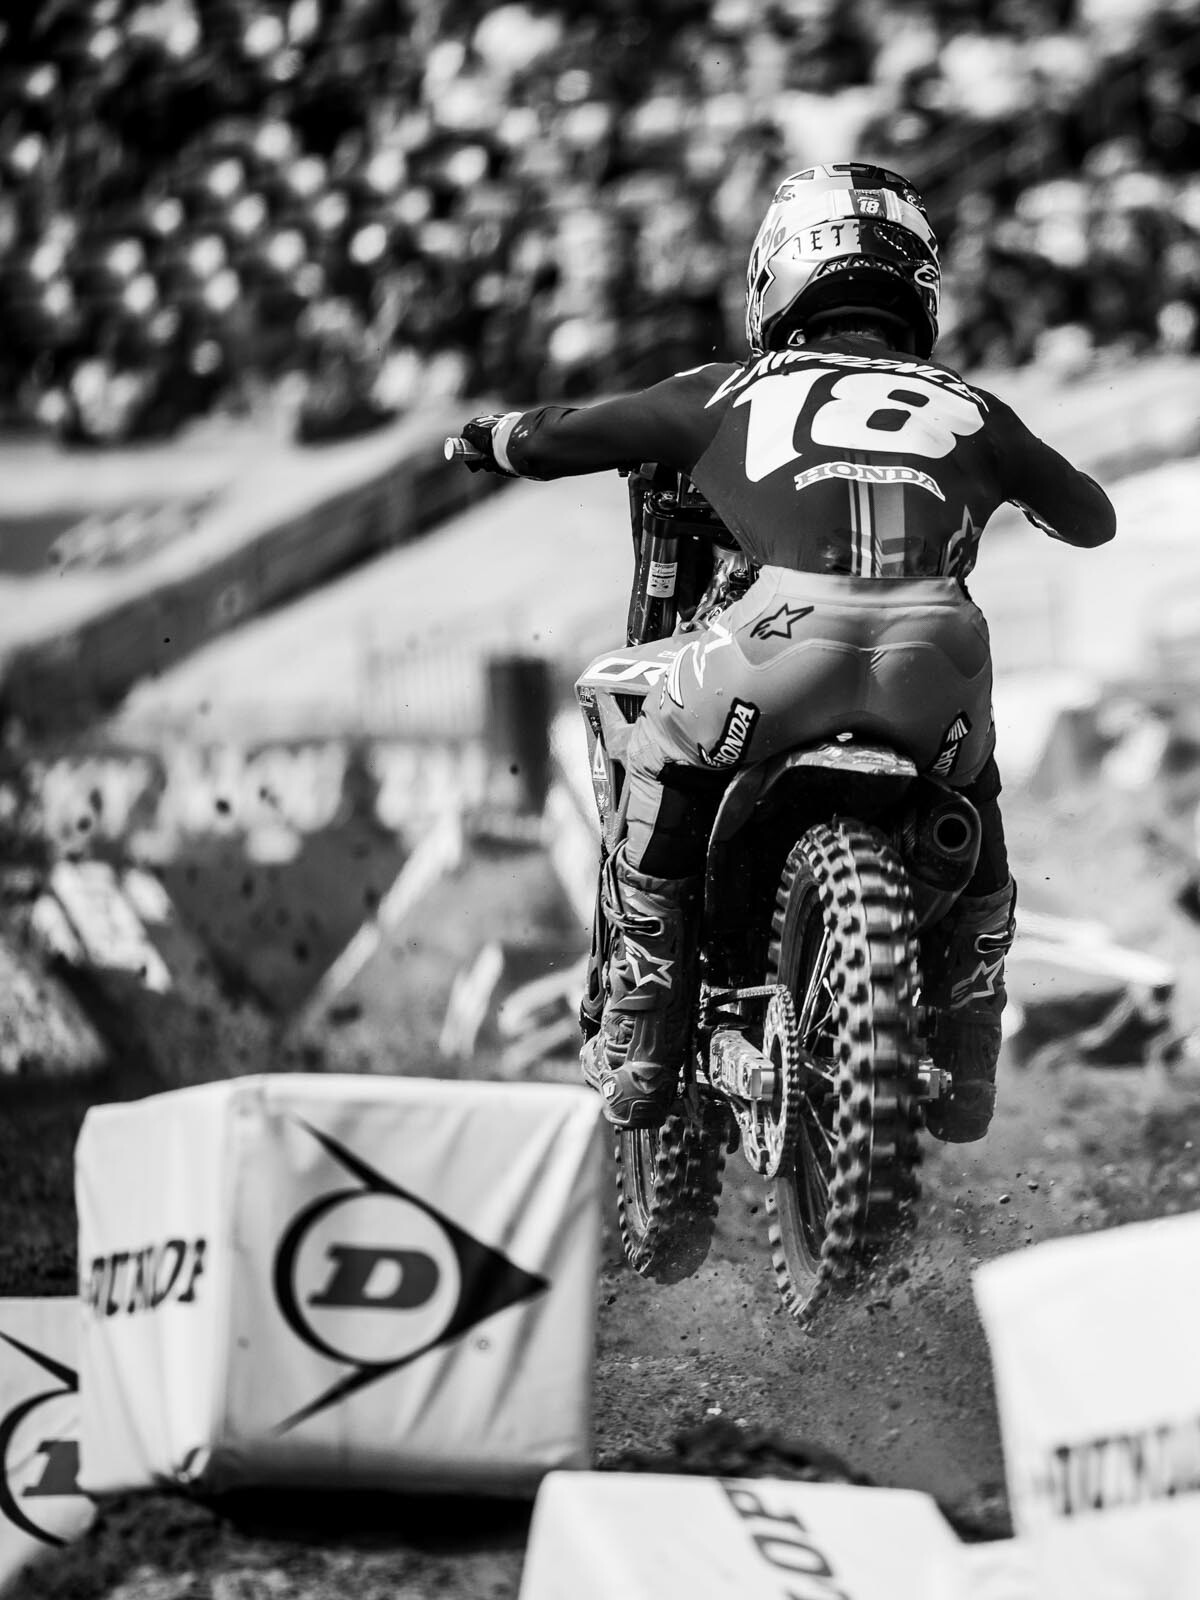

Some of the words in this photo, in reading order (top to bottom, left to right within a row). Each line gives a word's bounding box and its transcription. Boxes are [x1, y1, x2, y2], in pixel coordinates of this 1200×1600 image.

[857, 198, 880, 214] 18
[733, 368, 984, 482] 18
[794, 461, 946, 502] HONDA
[713, 704, 755, 765] HONDA
[308, 1244, 440, 1310] D
